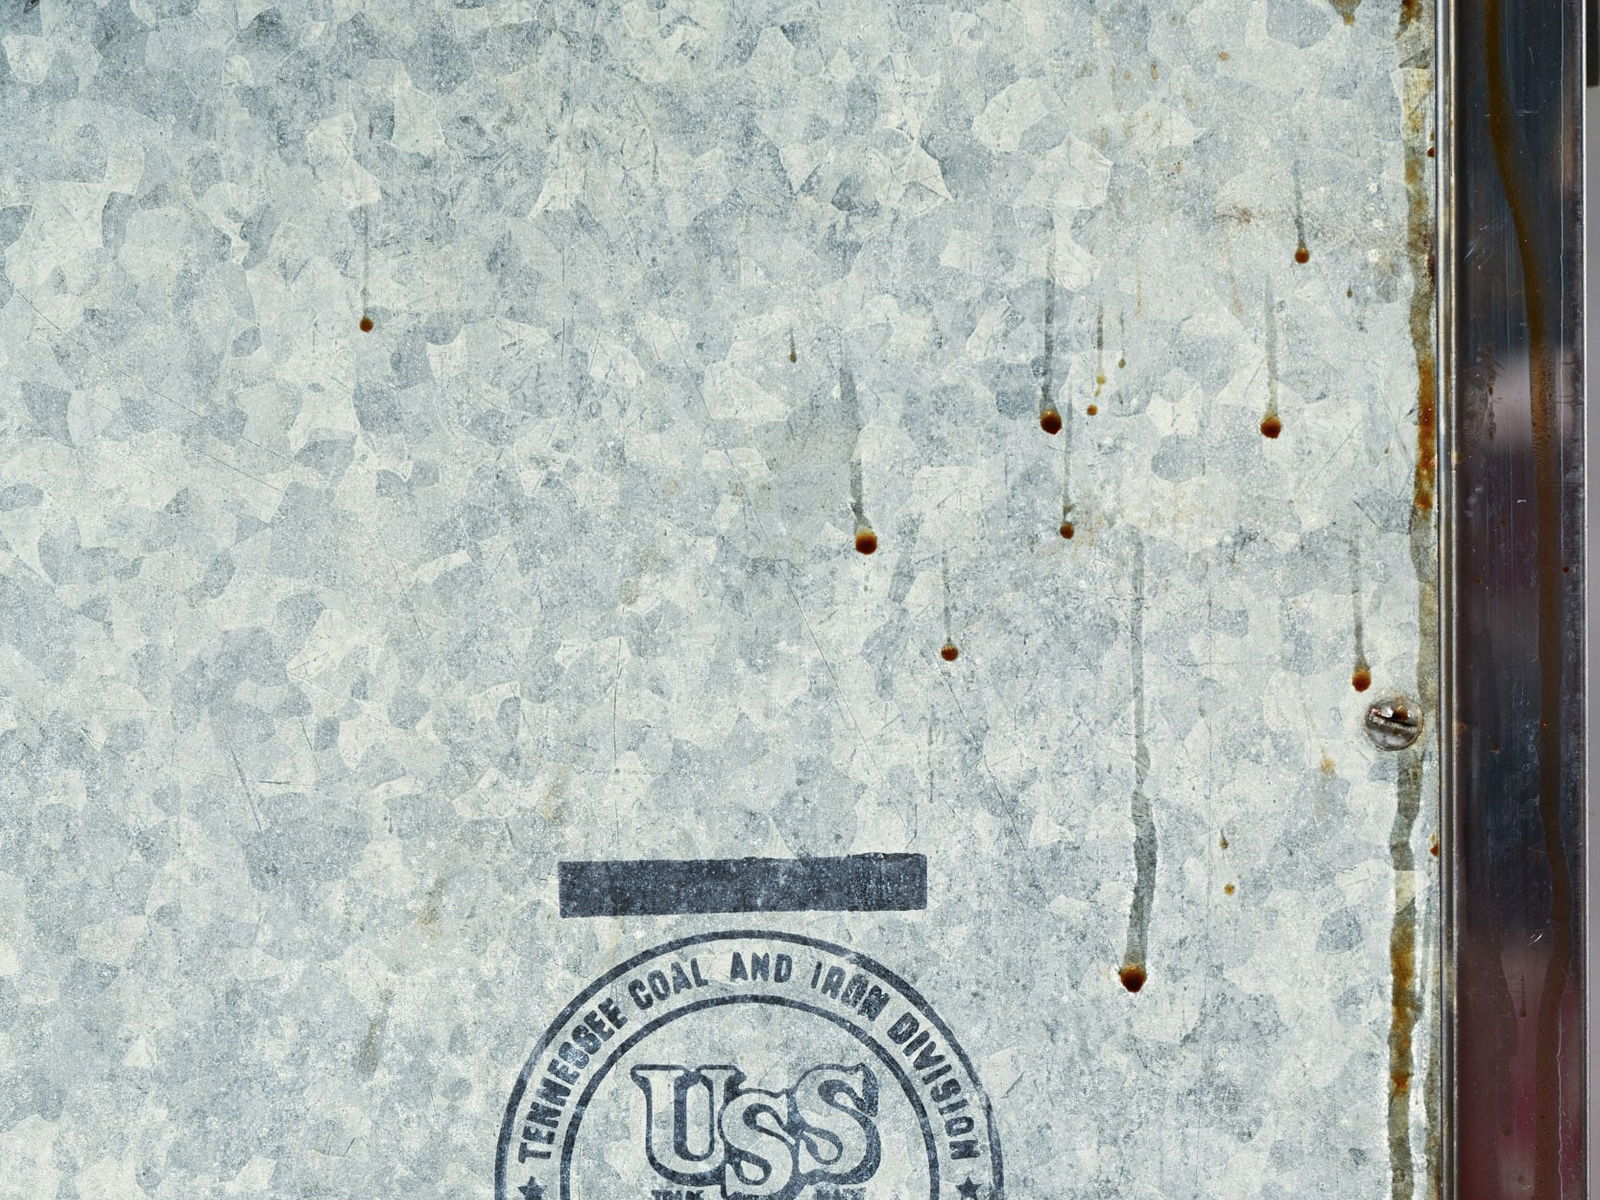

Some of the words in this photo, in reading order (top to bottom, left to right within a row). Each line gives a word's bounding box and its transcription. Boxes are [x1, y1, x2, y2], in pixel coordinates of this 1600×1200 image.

[518, 998, 627, 1164] TENNESSEE
[628, 957, 709, 1011] COAL
[730, 951, 793, 983] AND
[811, 961, 890, 1022] IRON
[887, 1011, 981, 1161] DIVISION
